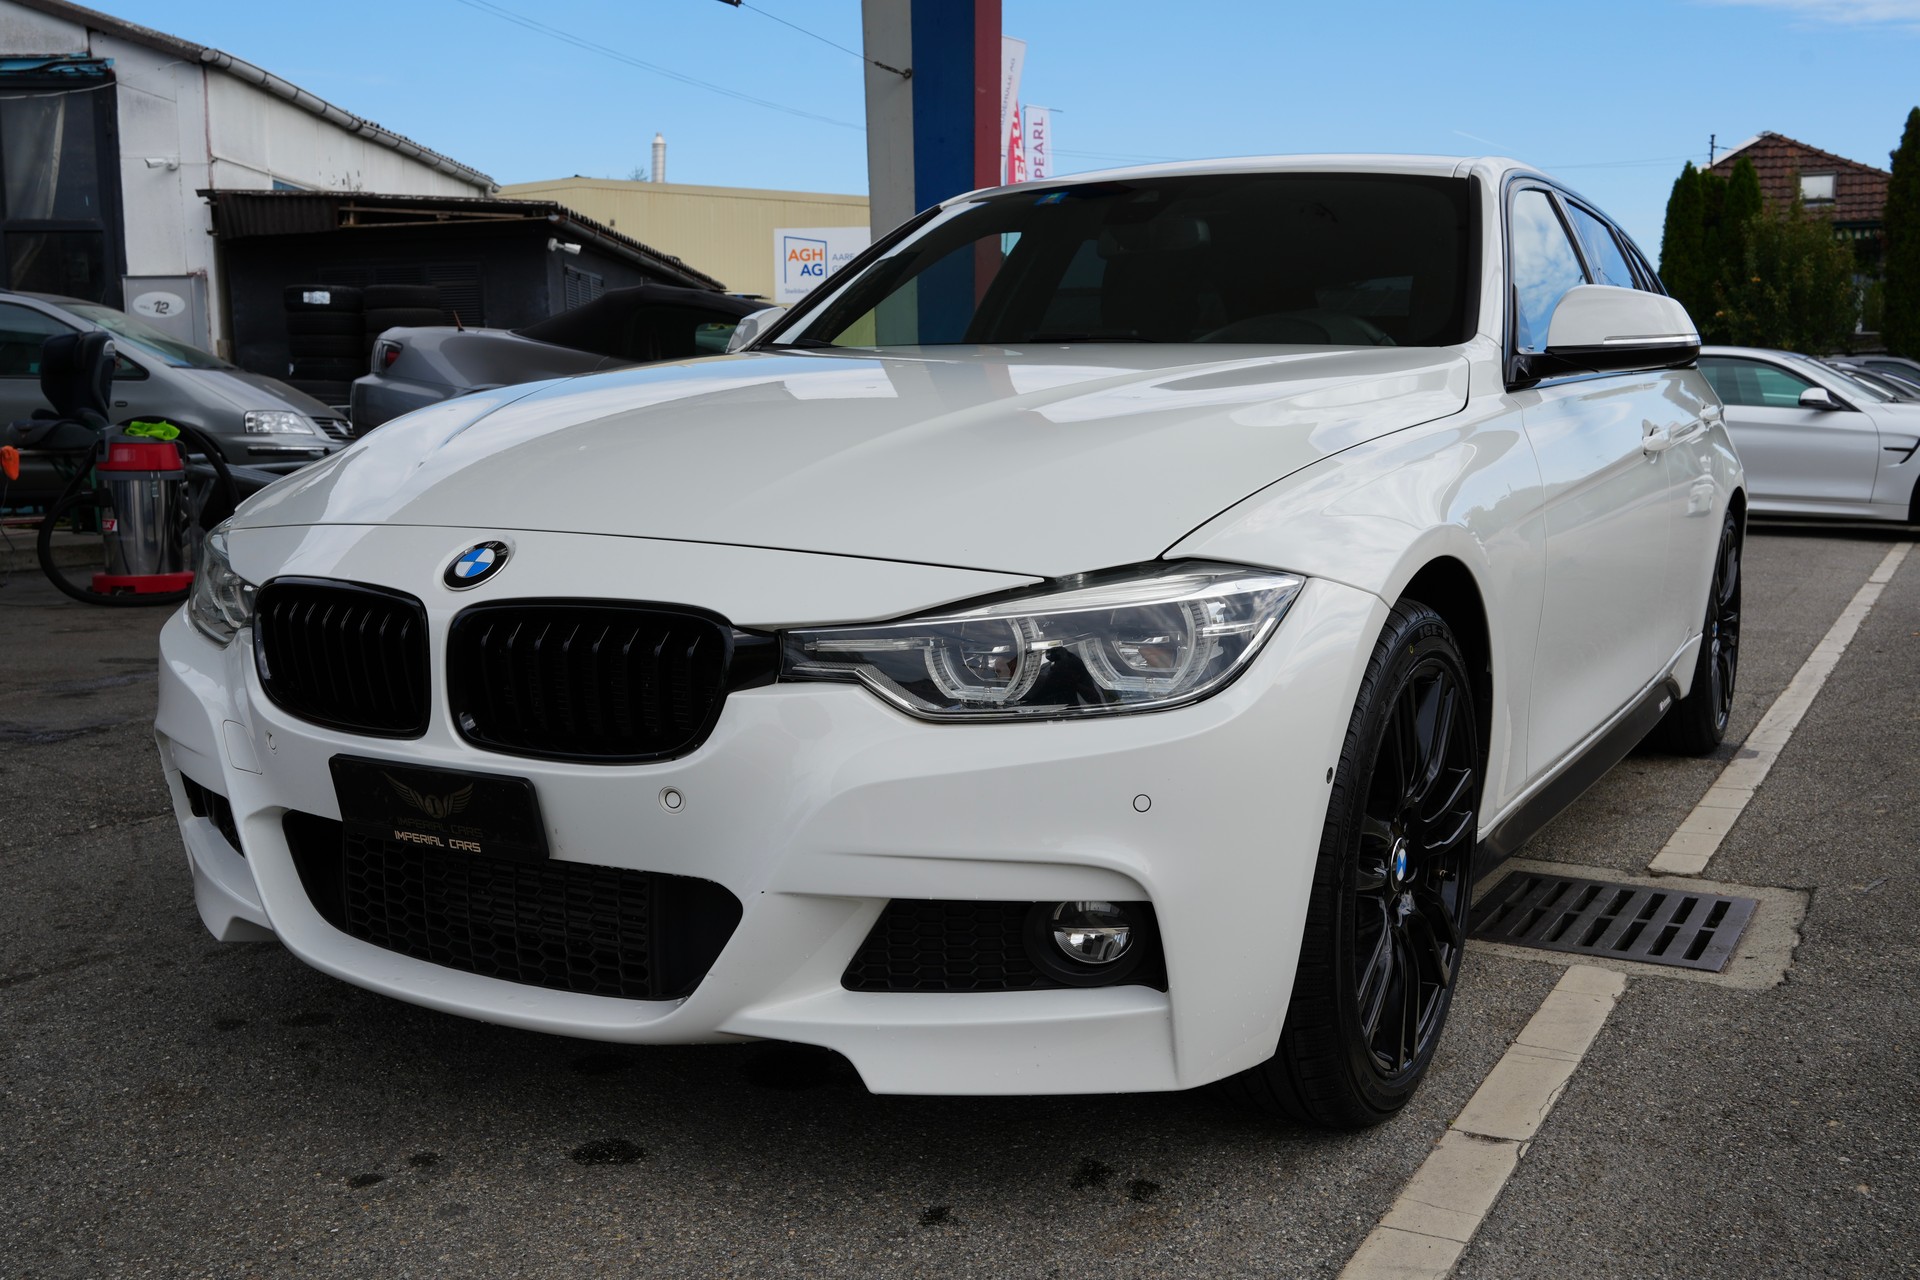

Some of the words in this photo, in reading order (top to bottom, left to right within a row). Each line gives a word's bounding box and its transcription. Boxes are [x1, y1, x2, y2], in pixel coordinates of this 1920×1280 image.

[1033, 116, 1045, 179] PEARL
[788, 248, 823, 262] AGH
[800, 263, 823, 276] AG
[154, 300, 170, 315] 12
[395, 817, 448, 832] IMPERIAL
[451, 824, 483, 839] CARS
[395, 831, 445, 847] IMPERIAL
[449, 839, 481, 853] CARS
